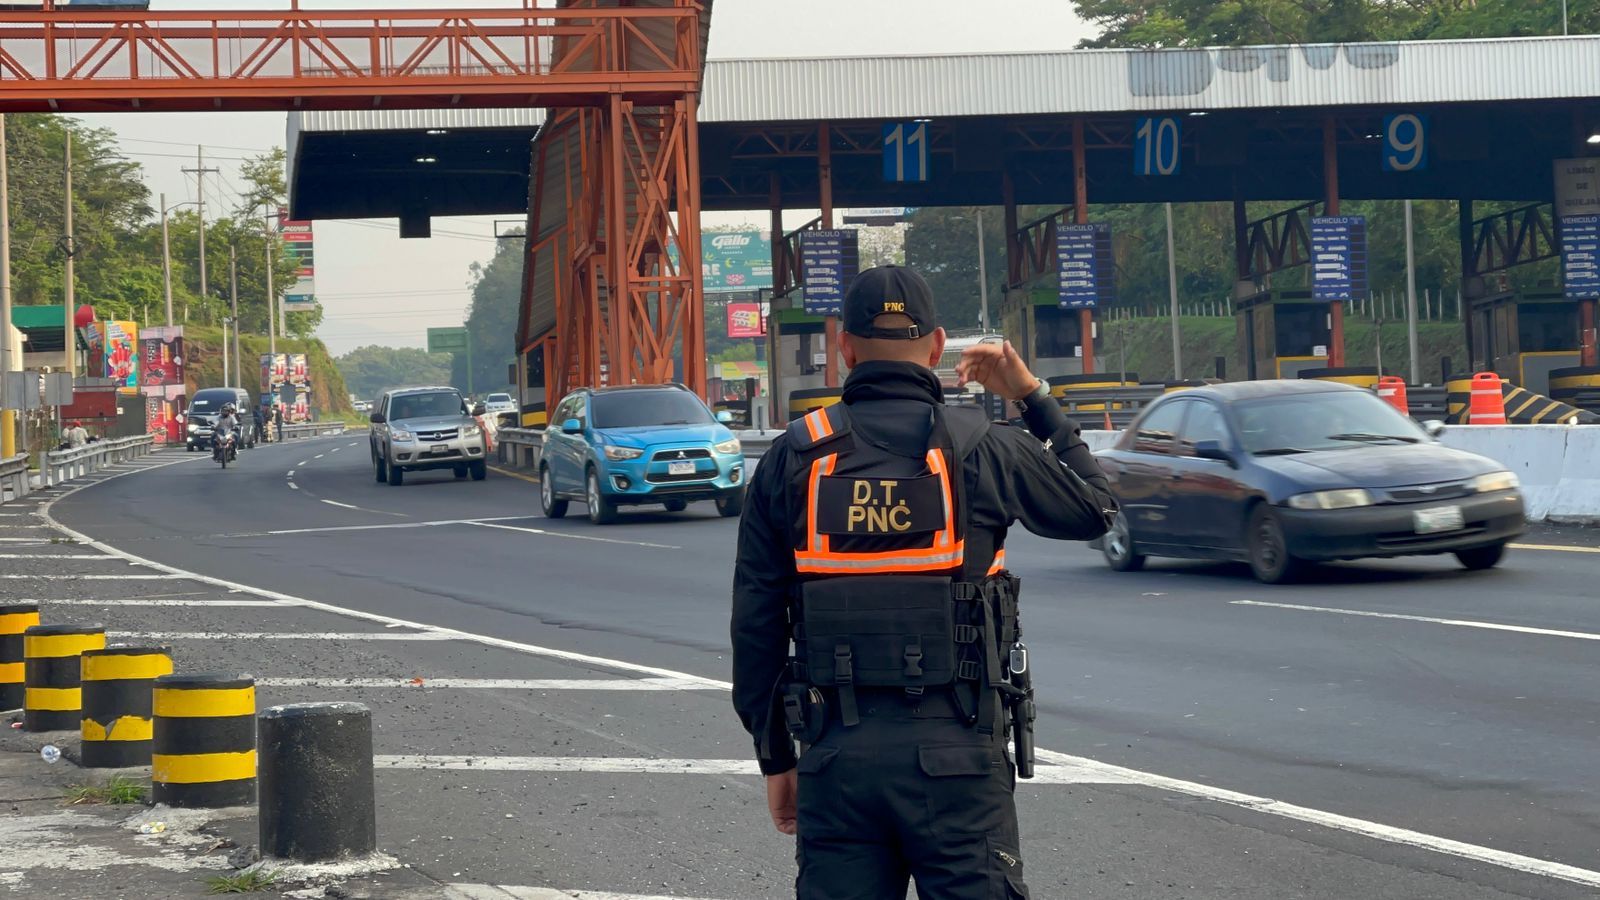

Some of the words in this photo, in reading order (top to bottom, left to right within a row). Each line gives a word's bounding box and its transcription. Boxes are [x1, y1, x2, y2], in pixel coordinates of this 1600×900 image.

[885, 123, 926, 181] 11
[1136, 118, 1179, 175] 10
[1387, 114, 1425, 171] 9
[1566, 166, 1596, 175] LIBRO
[1576, 182, 1589, 190] DE
[711, 234, 751, 249] Gallo
[883, 302, 905, 312] PNC
[853, 480, 906, 505] D.T.
[847, 505, 912, 532] PNC
